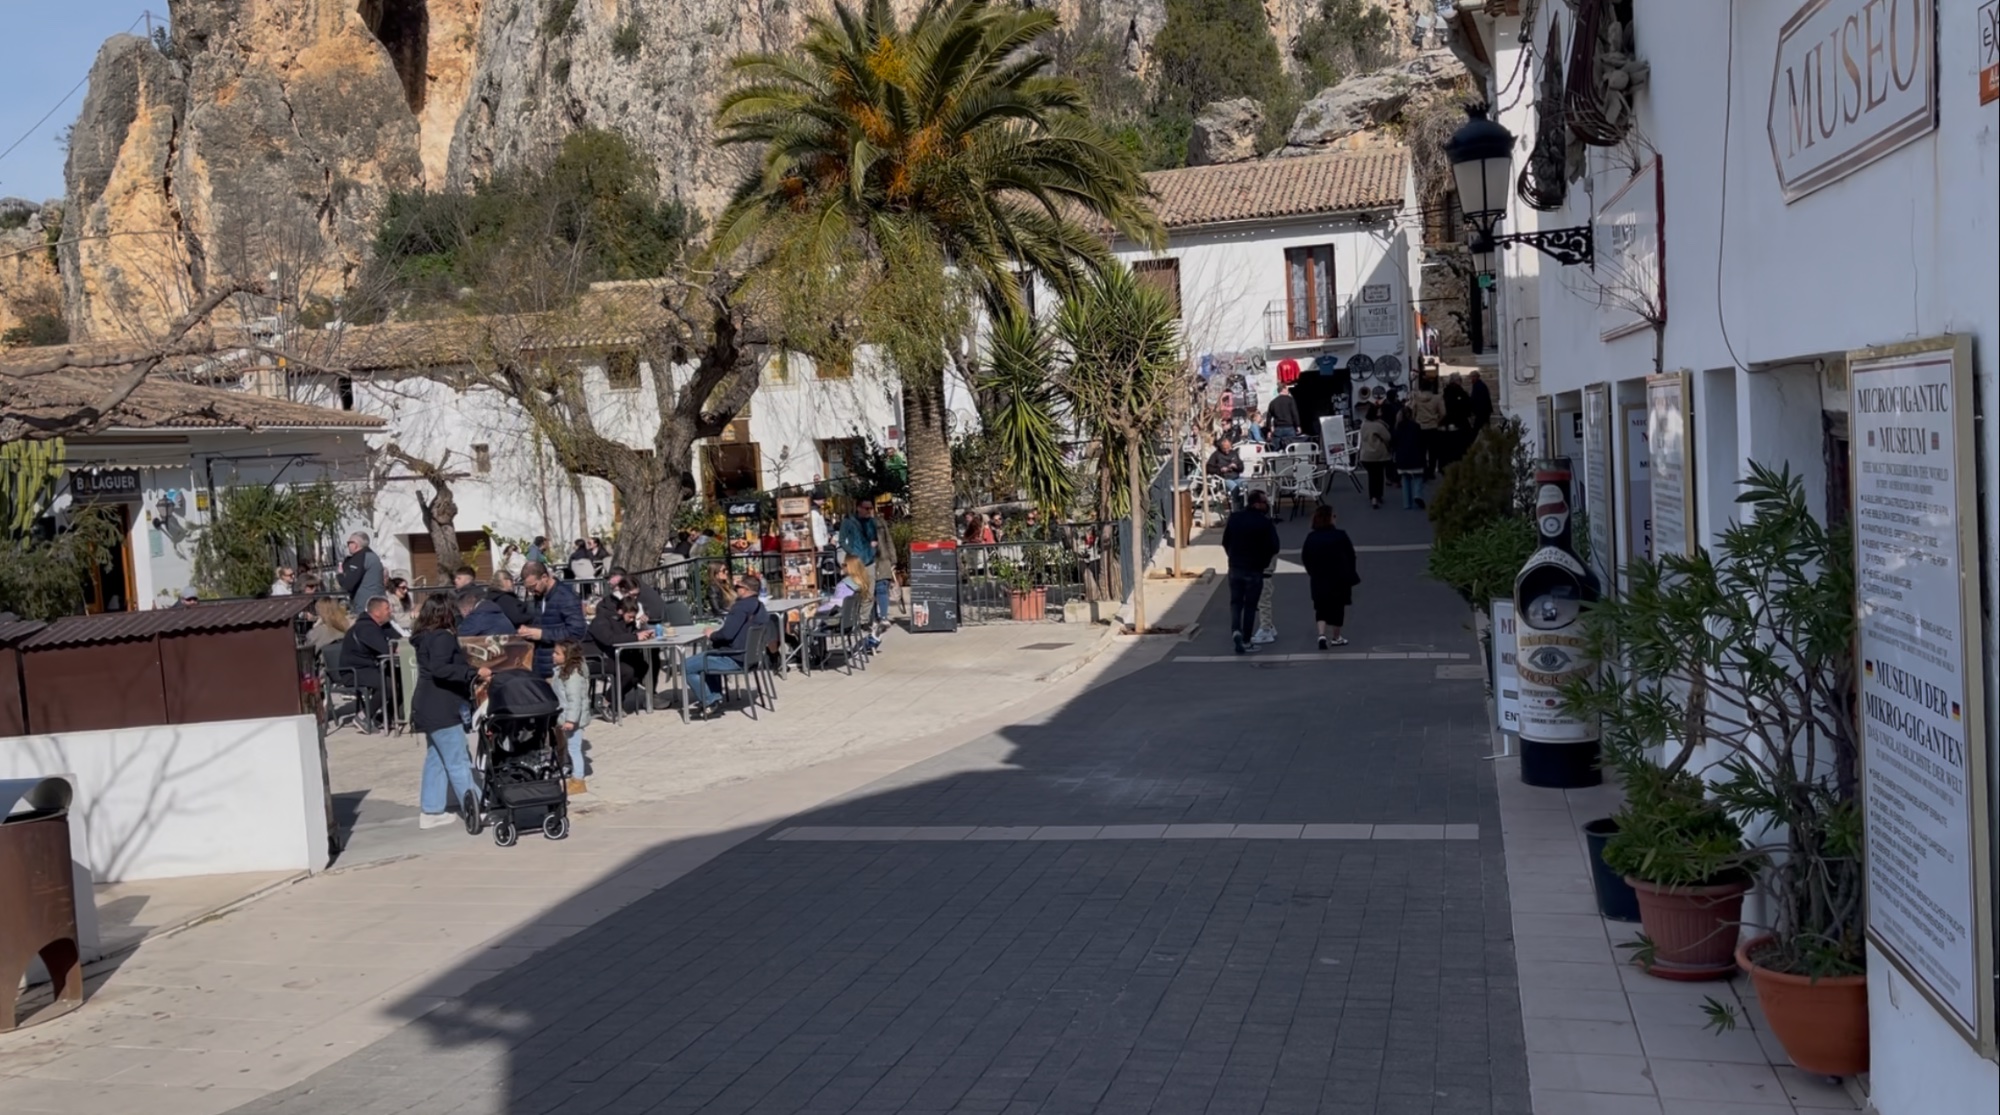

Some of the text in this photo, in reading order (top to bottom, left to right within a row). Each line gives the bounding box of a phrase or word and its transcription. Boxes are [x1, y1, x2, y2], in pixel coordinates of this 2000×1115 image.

[1786, 0, 1921, 159] MUSEO
[1857, 382, 1949, 414] MICROGIGANTIC
[1879, 426, 1927, 456] MUSEUM
[76, 476, 136, 491] BALAGUER
[1876, 659, 1949, 719] MUSEUM DER
[1865, 691, 1963, 769] MIKRO-GIGANTEN
[1946, 770, 1963, 796] WELT
